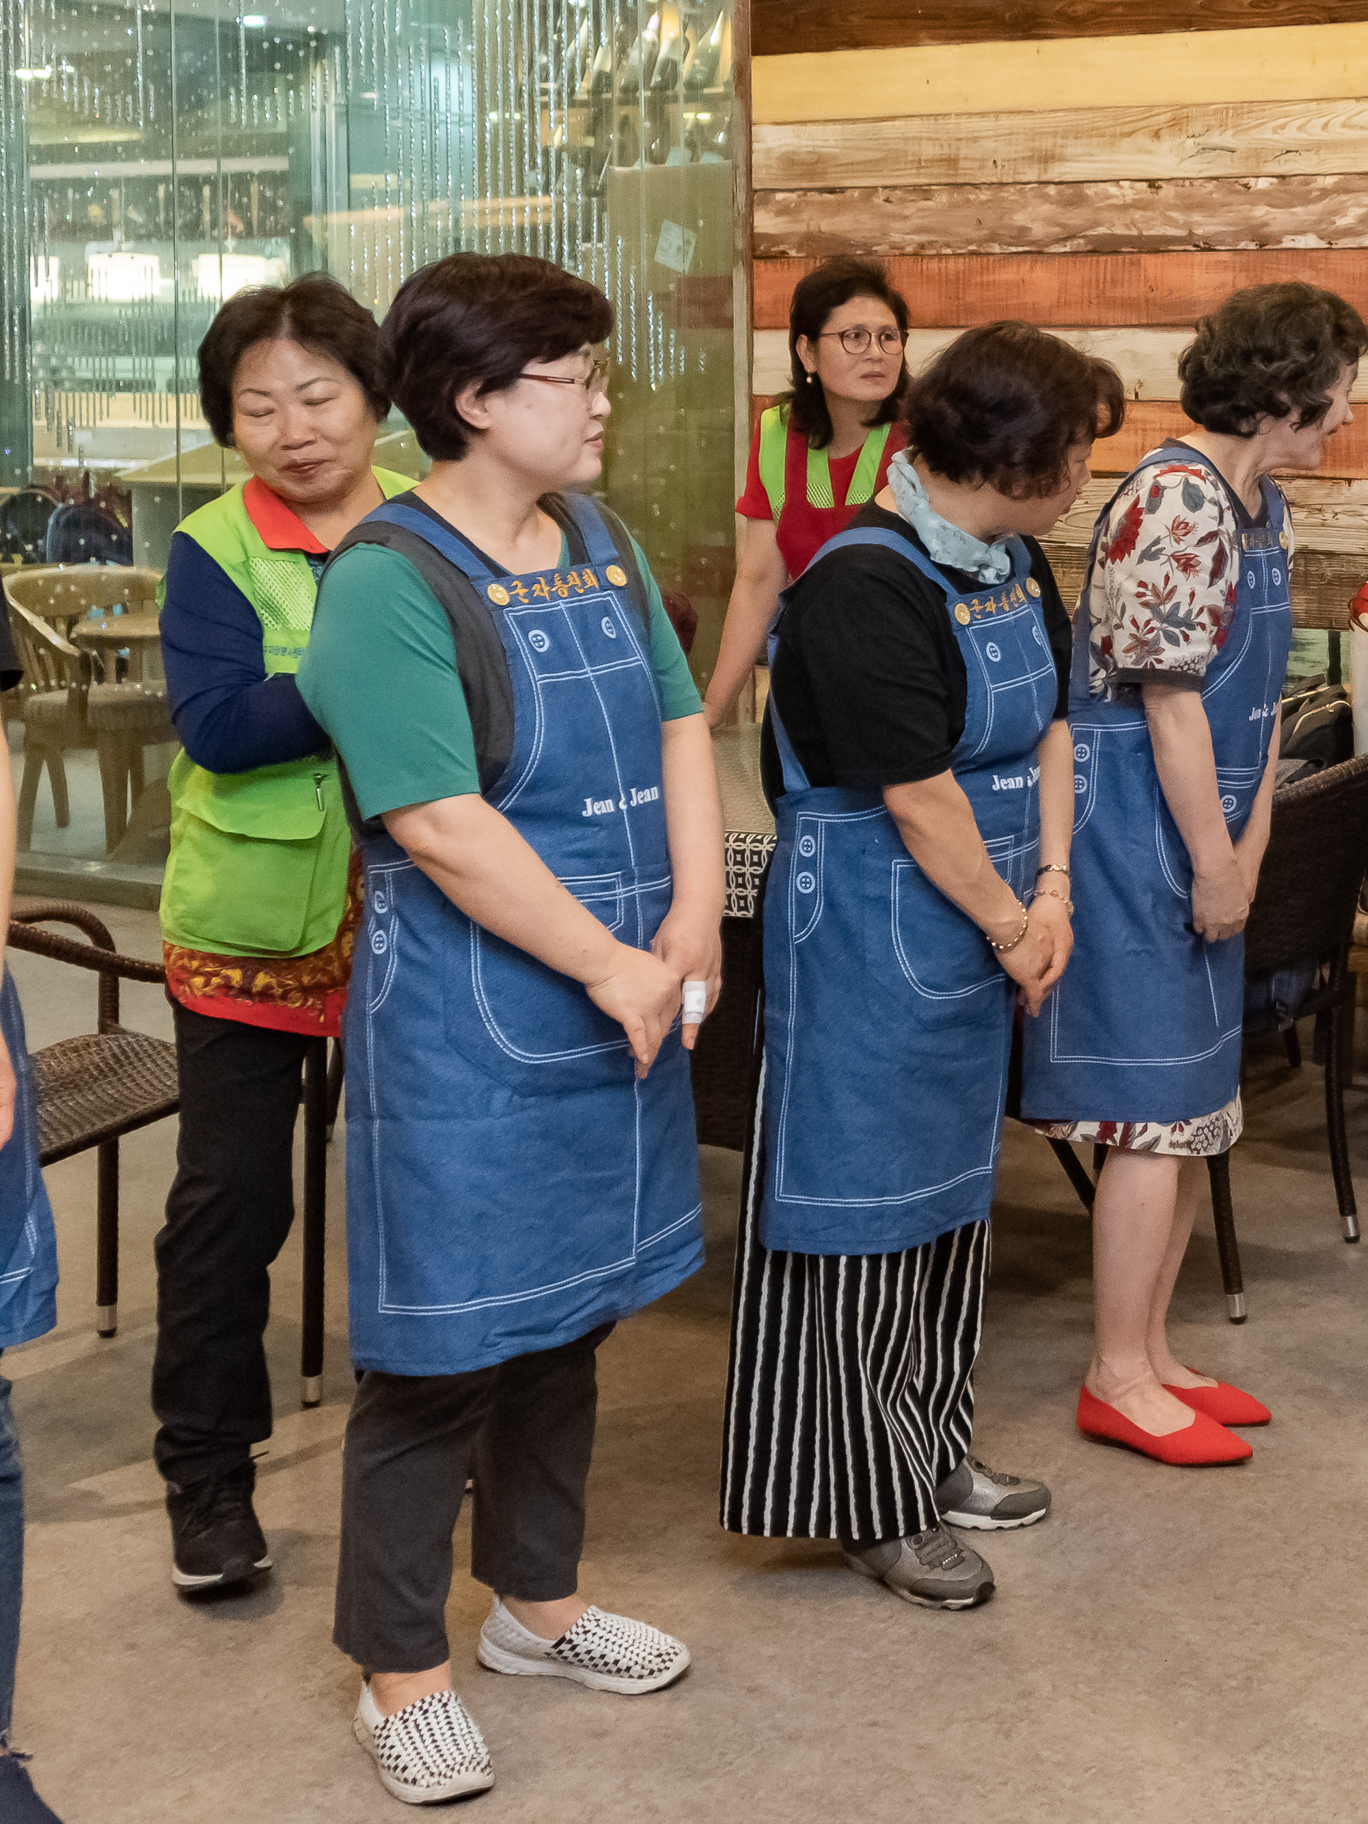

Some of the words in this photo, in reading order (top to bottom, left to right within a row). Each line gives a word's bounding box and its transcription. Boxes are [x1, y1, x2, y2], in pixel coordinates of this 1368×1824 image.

[992, 774, 1024, 791] Jean
[581, 797, 615, 817] Jean
[629, 786, 659, 807] Jean
